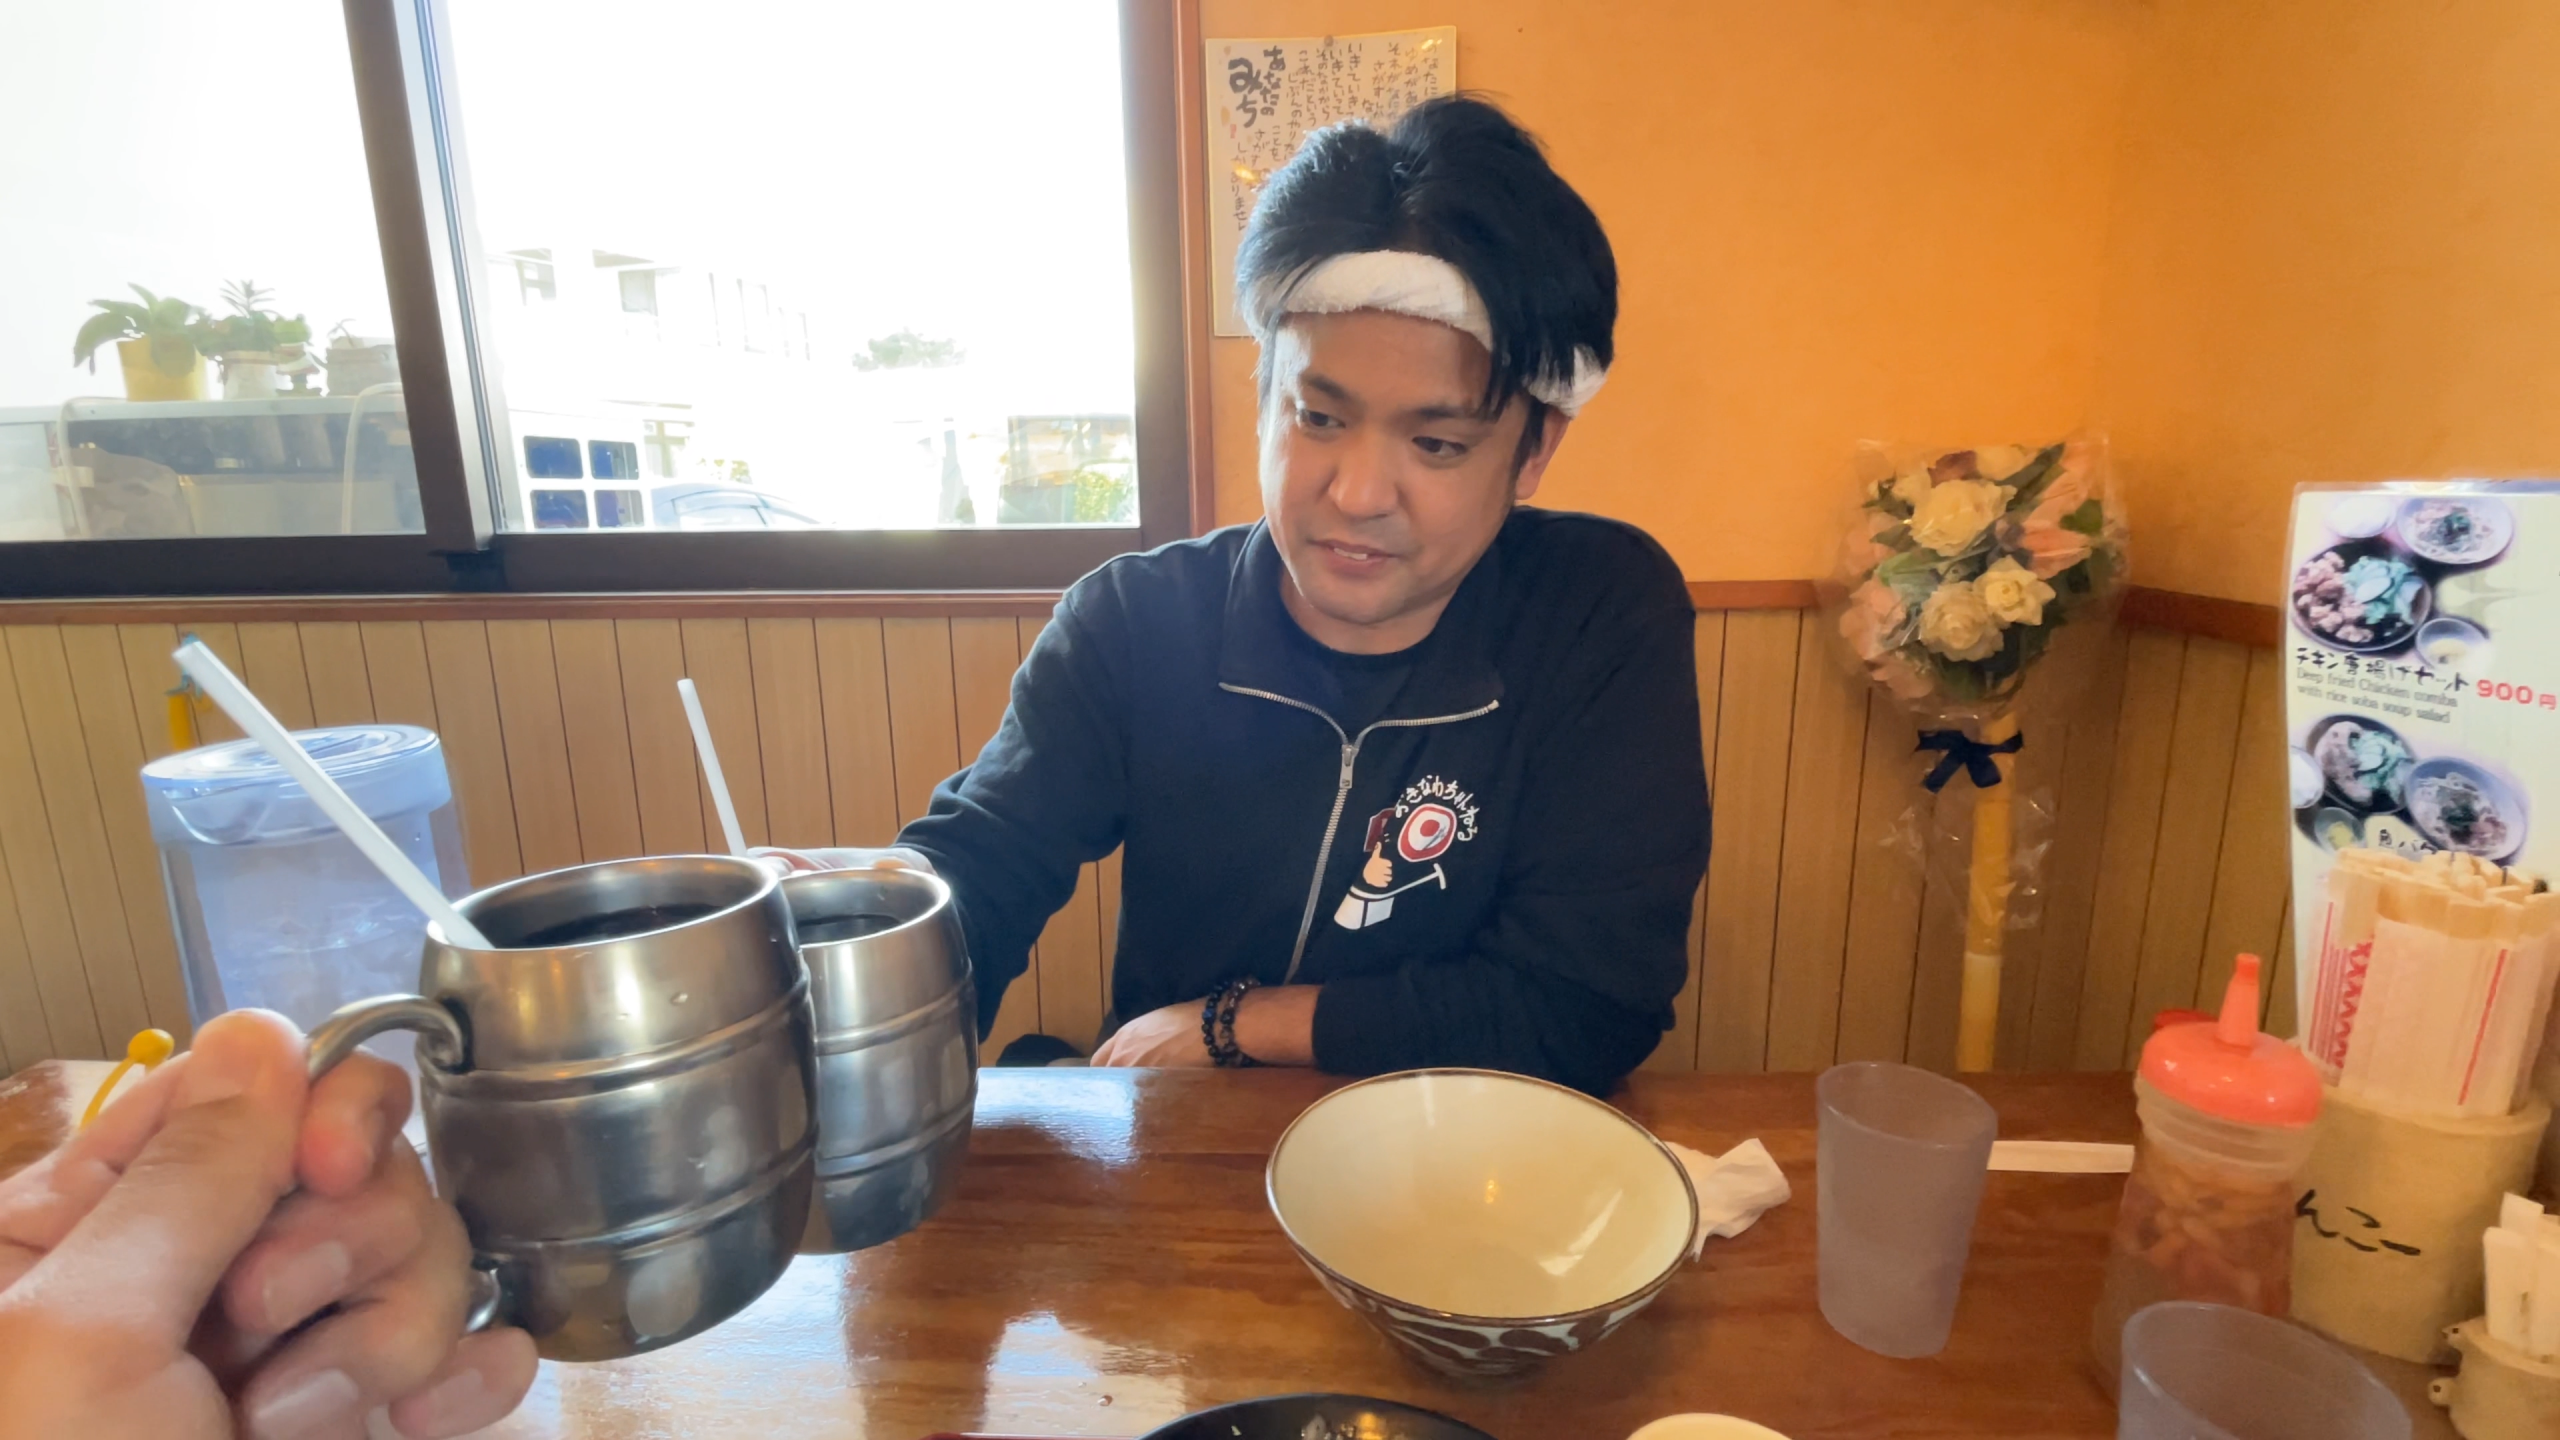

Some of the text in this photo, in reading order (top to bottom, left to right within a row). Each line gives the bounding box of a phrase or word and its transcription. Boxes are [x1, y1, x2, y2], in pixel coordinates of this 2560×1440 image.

[1228, 57, 1263, 128] みち
[1260, 45, 1287, 116] あなたの
[2297, 666, 2324, 684] Deep
[2327, 672, 2356, 689] fried
[2359, 677, 2410, 698] Chicken
[2297, 685, 2323, 698] with
[2326, 690, 2348, 703] rice
[1395, 774, 1479, 842] おきなわちゃんねる
